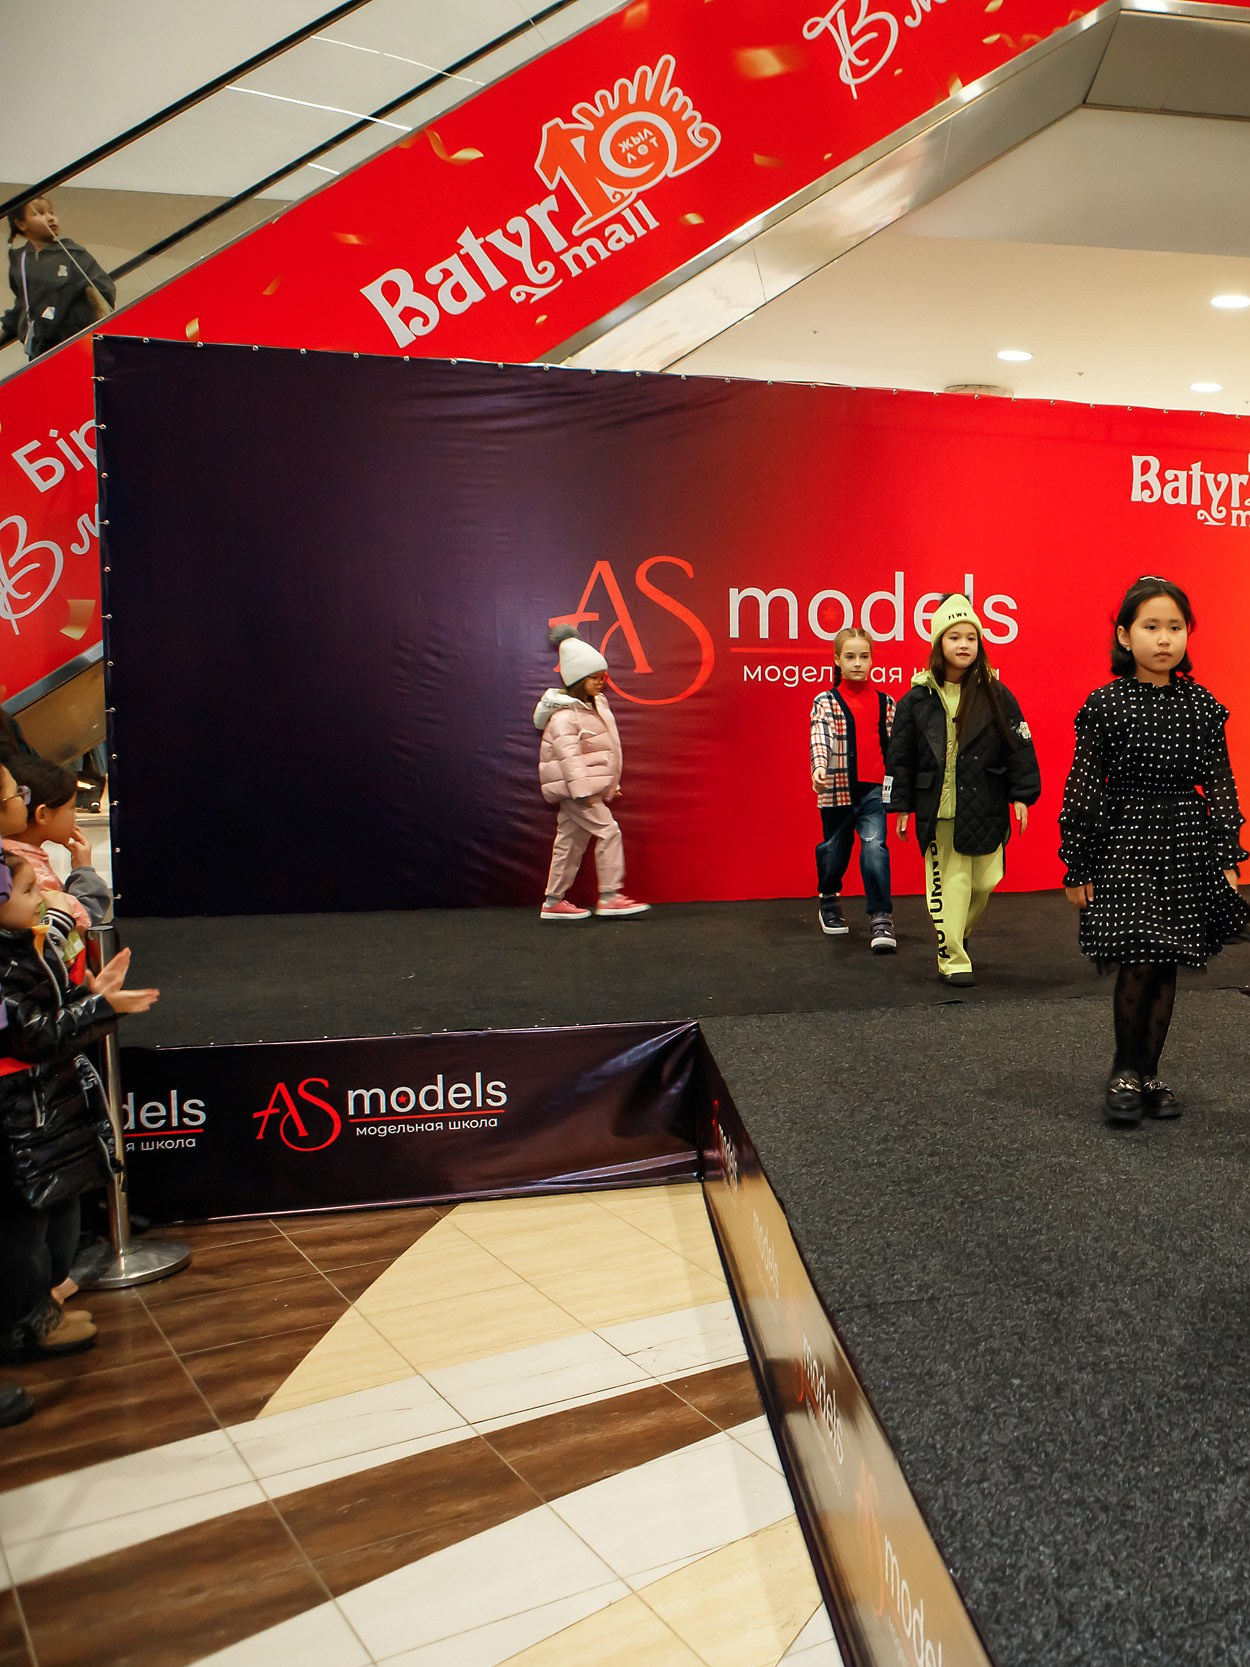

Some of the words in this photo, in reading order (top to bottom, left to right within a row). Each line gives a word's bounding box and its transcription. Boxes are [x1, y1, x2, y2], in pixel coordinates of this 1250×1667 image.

[359, 194, 569, 349] Batyr
[559, 199, 660, 277] mall
[1131, 455, 1249, 525] Batyr
[548, 556, 715, 706] AS
[743, 665, 902, 687] моделая
[122, 1089, 206, 1130] dels
[141, 1137, 196, 1152] школа
[252, 1077, 342, 1151] AS
[347, 1072, 508, 1115] models
[356, 1121, 444, 1138] модельная
[448, 1117, 498, 1131] школа
[803, 1333, 843, 1465] models
